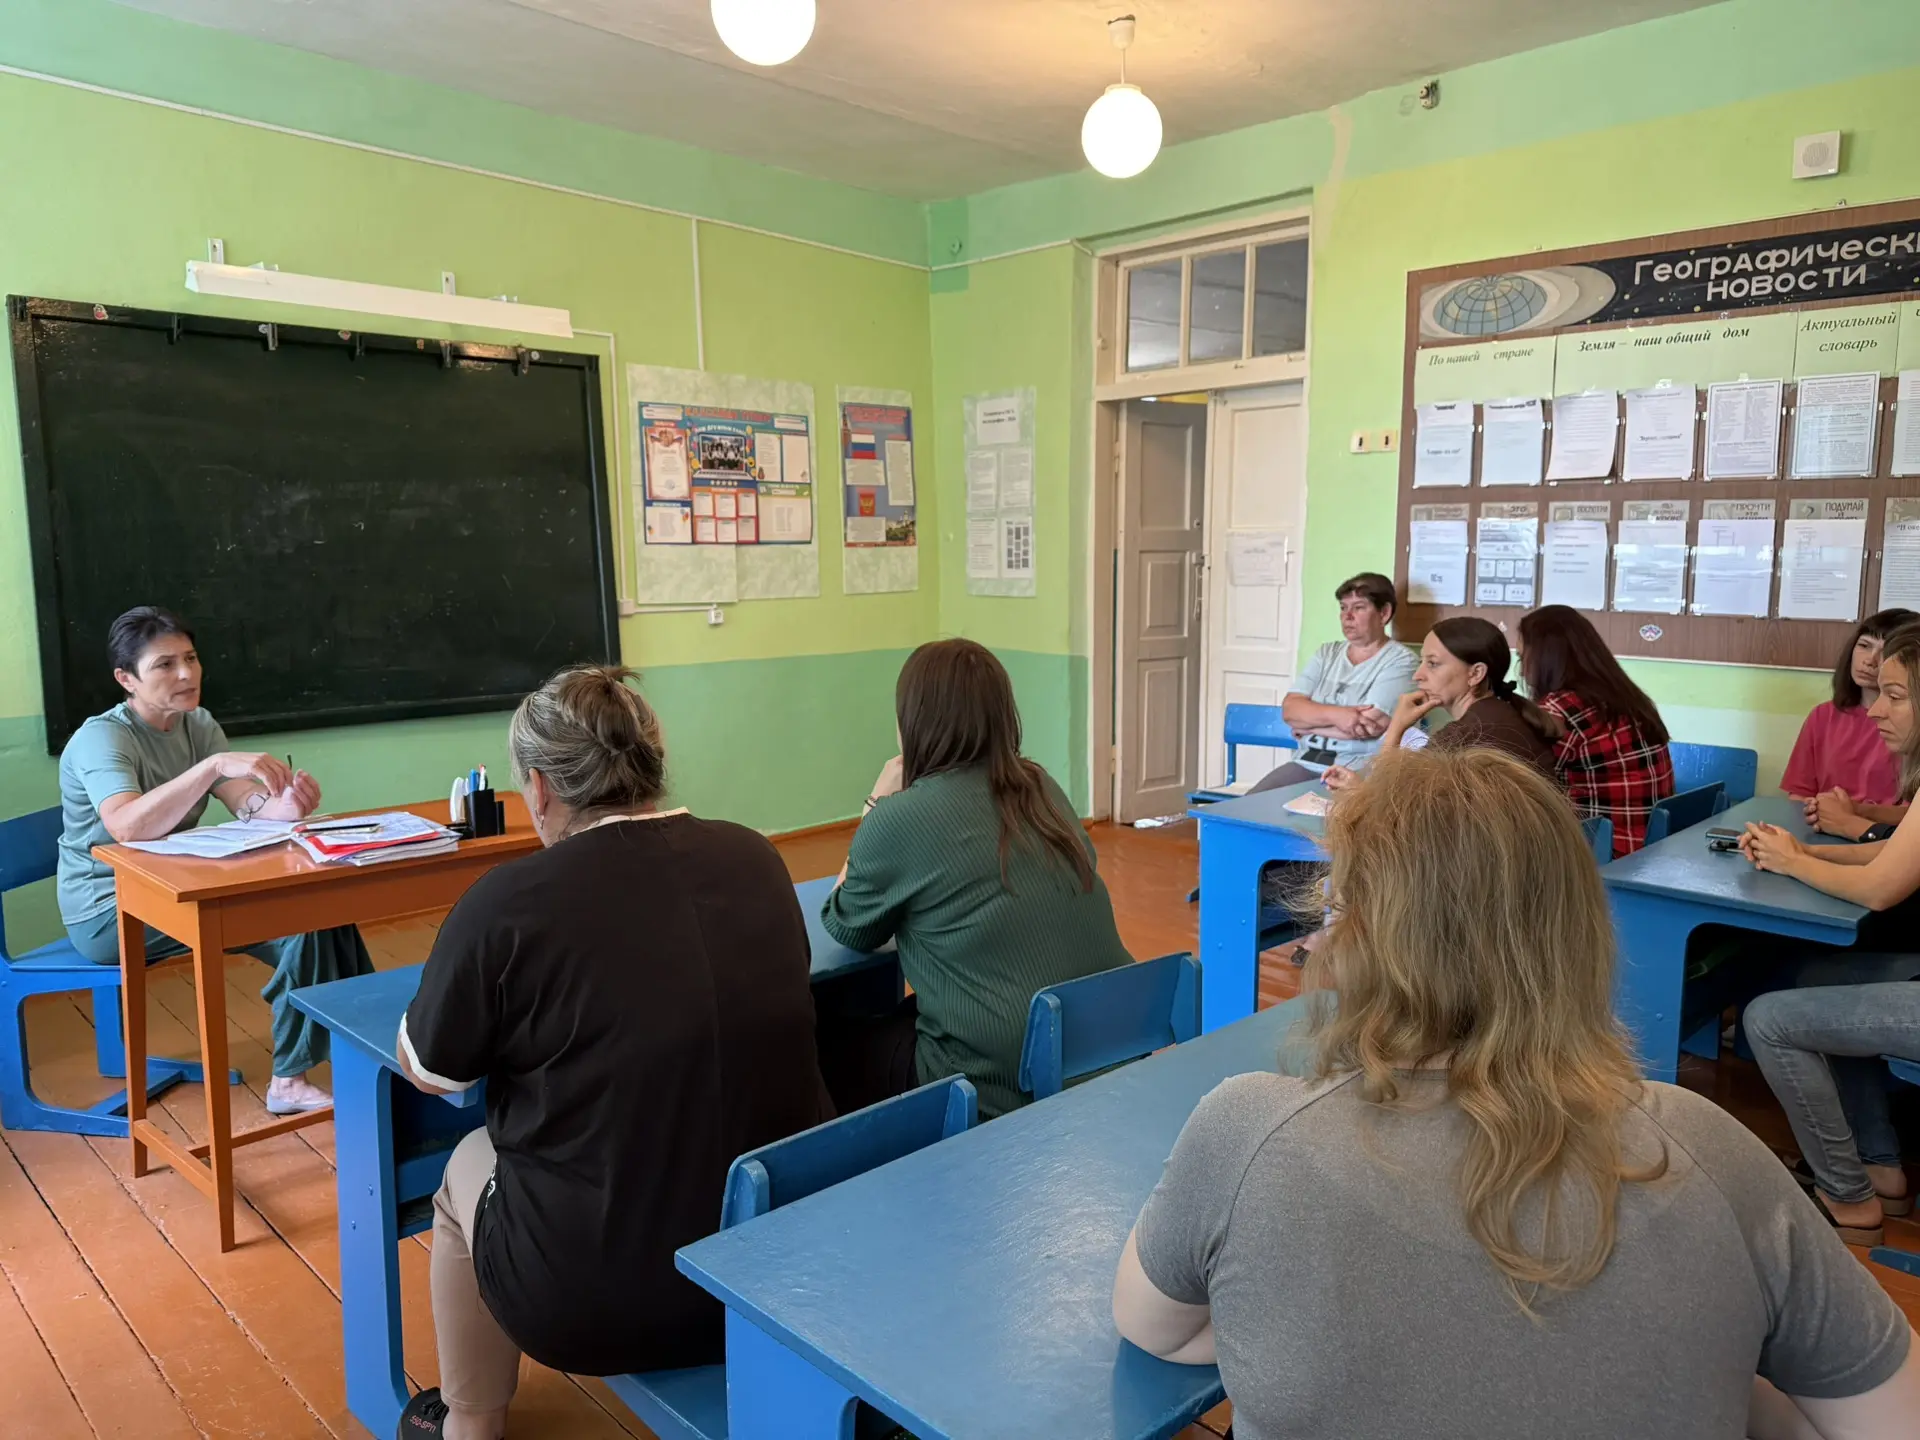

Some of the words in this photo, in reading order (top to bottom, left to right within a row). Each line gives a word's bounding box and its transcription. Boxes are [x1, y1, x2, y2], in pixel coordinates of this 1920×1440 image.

[1634, 231, 1920, 286] Географическ
[1801, 311, 1898, 332] Актуальный
[1578, 340, 1616, 352] Земля
[1634, 335, 1662, 347] наш
[1665, 329, 1712, 345] общий
[1722, 327, 1750, 339] дом
[1819, 339, 1878, 352] словарь
[1428, 354, 1445, 366] По
[1446, 350, 1480, 365] нашей
[1493, 347, 1534, 361] стране
[1825, 500, 1864, 512] ПОДУМАЙ
